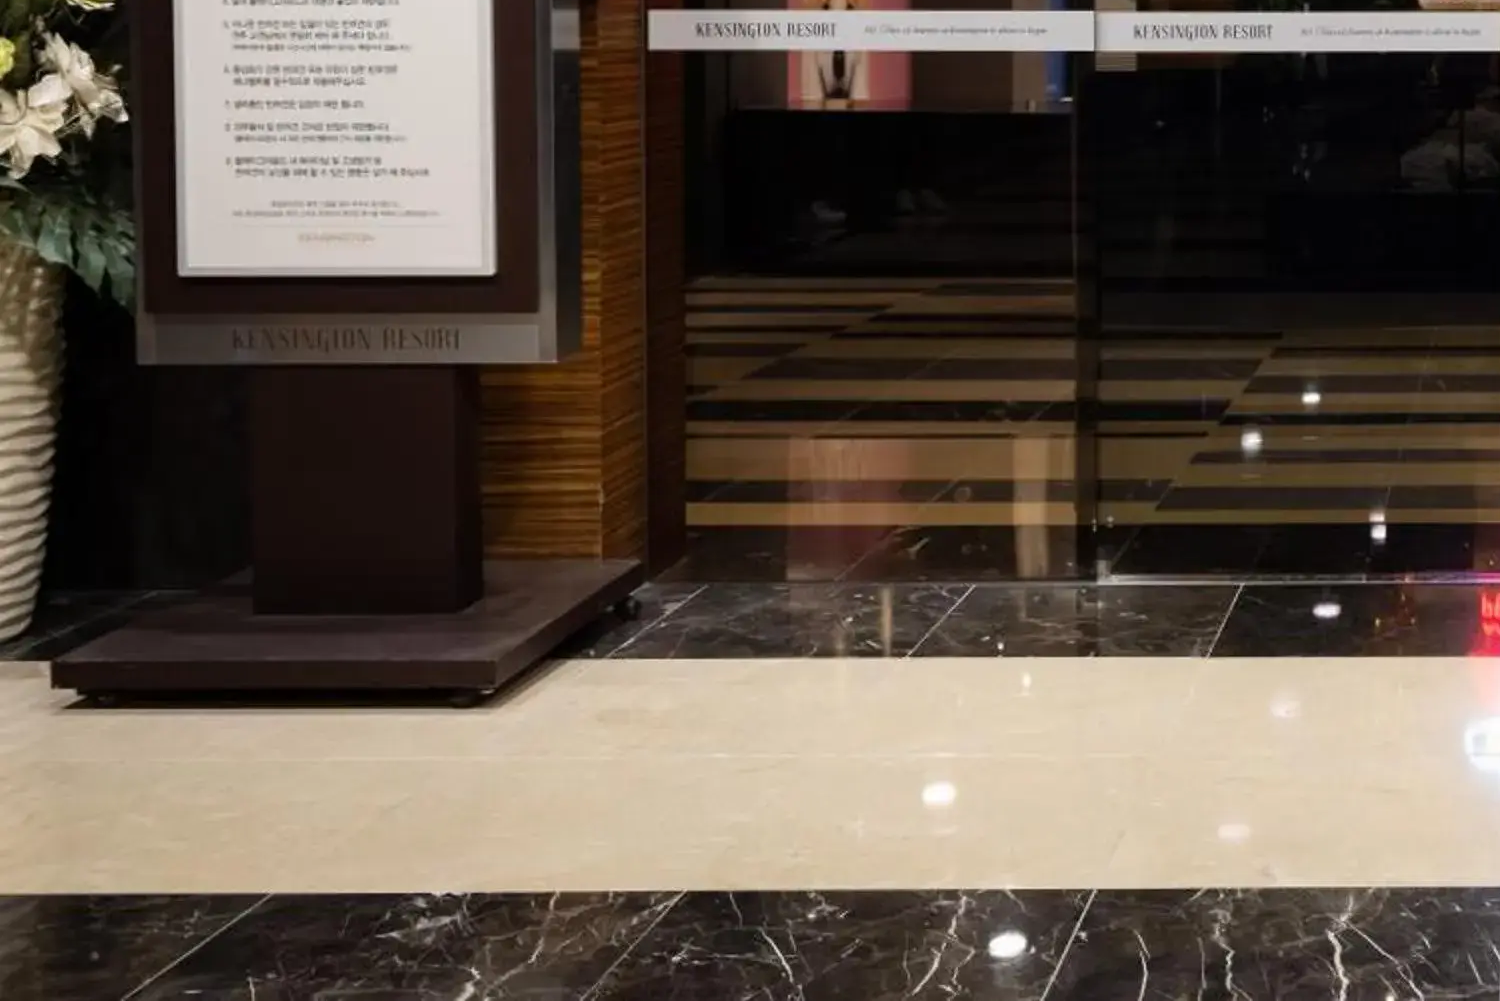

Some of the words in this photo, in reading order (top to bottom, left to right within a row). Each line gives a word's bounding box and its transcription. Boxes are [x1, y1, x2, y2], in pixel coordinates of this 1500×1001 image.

[695, 22, 781, 38] KENSINGTON
[787, 22, 836, 37] RESORT
[1133, 24, 1218, 40] KENSINGTON
[1222, 24, 1273, 39] RESORT
[231, 326, 372, 354] KENSINGTON
[381, 327, 462, 352] RESORT
